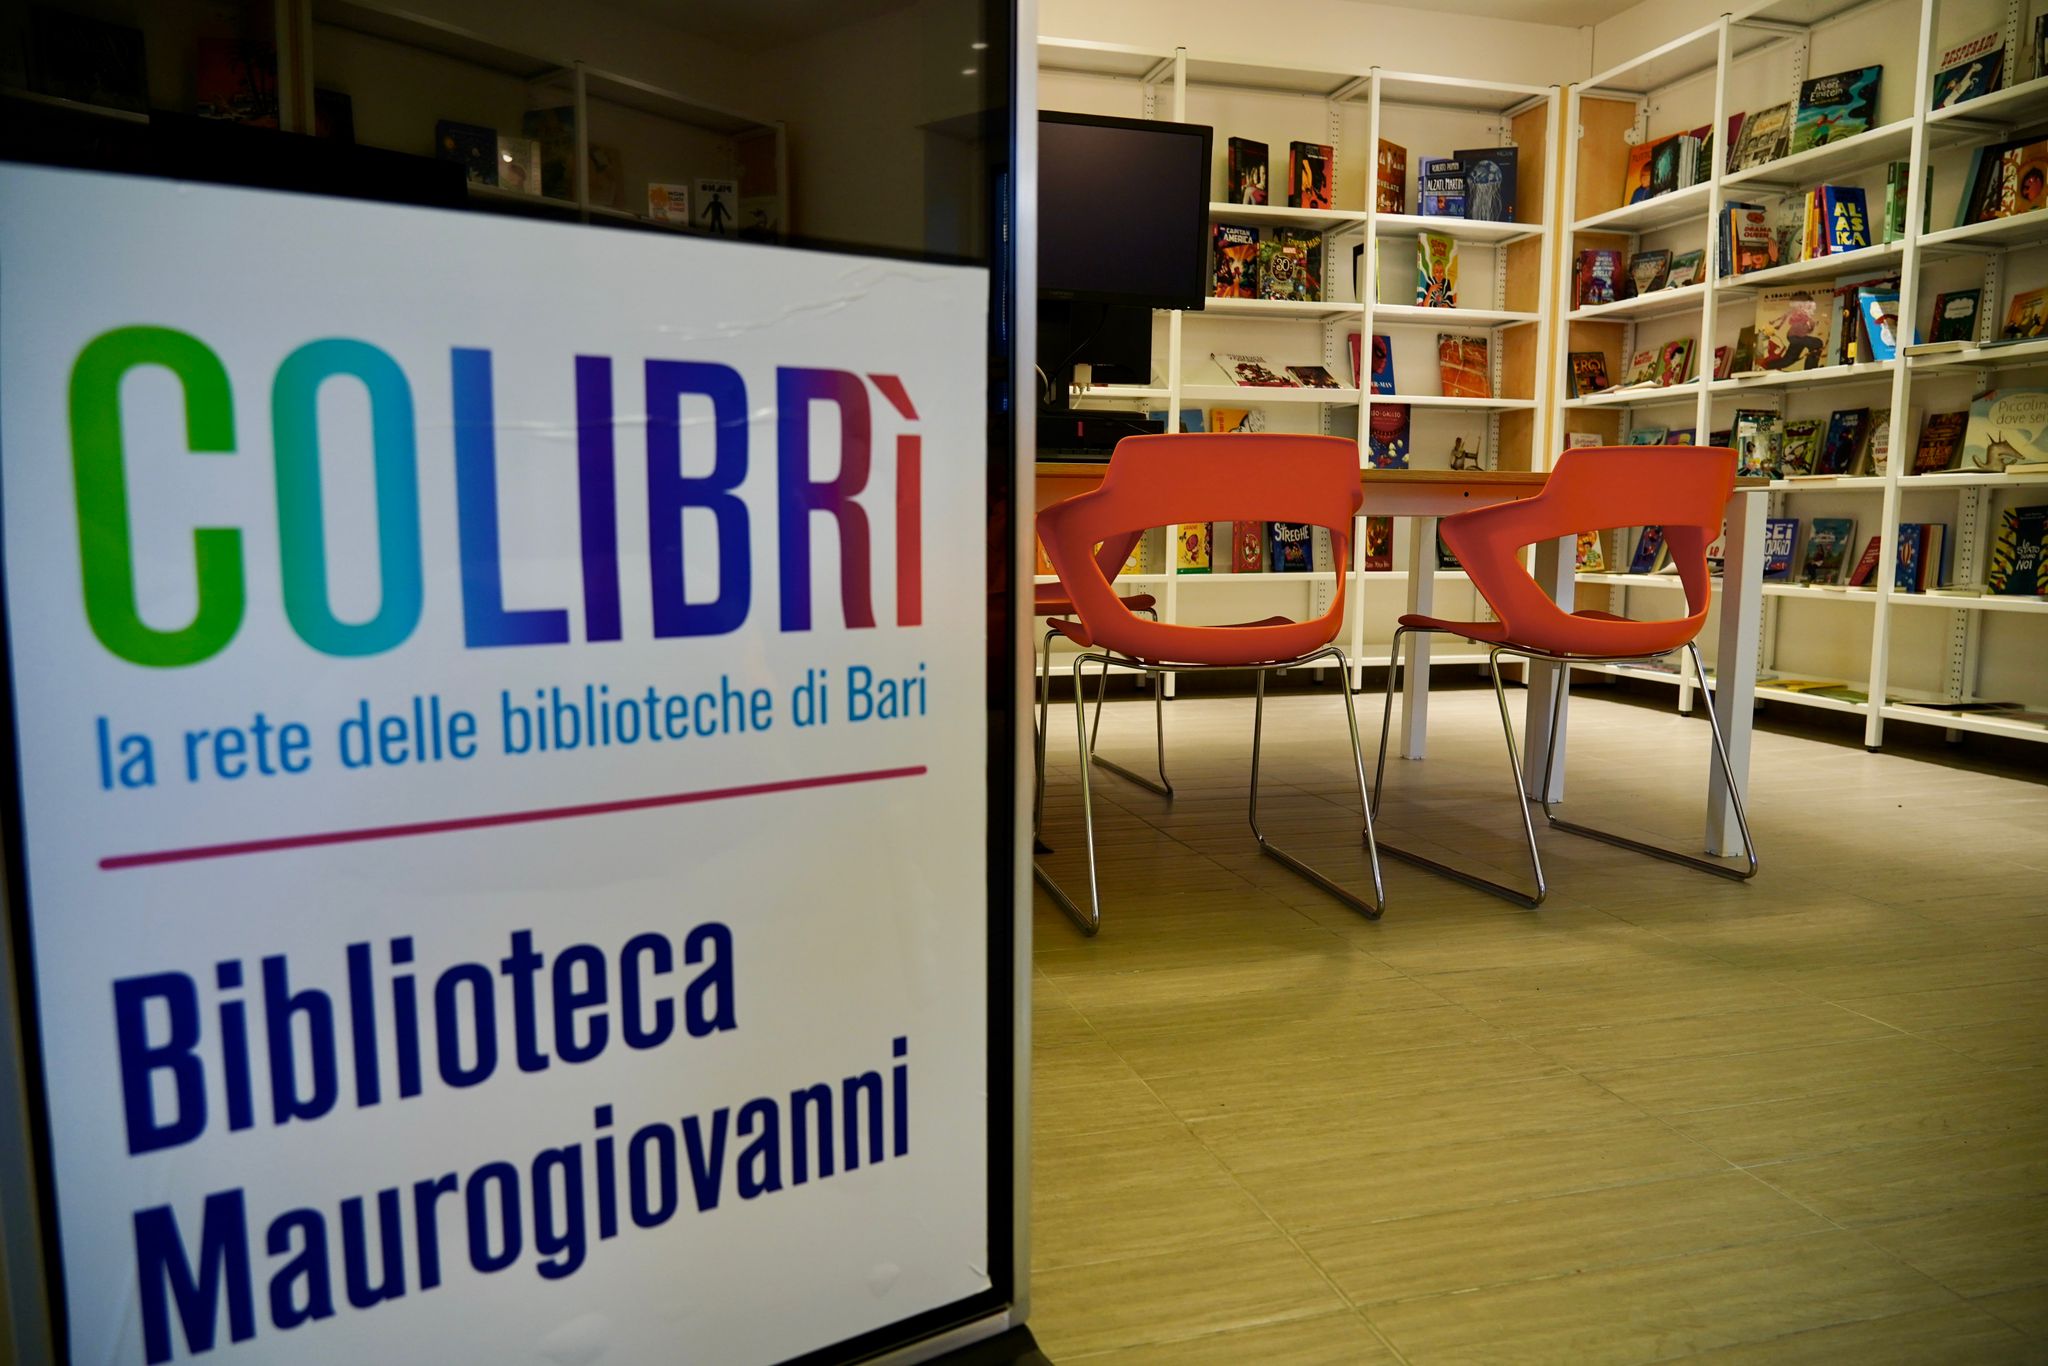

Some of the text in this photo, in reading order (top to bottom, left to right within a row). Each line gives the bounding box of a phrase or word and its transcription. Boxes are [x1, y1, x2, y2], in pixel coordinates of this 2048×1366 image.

[1941, 31, 1999, 67] DESPERADO
[1223, 233, 1253, 244] AMERICA
[1276, 257, 1290, 272] 30
[1997, 413, 2025, 425] dove
[68, 324, 922, 668] COLIBRÌ
[1274, 522, 1310, 542] STREGHE
[2016, 560, 2033, 571] NOI
[96, 662, 927, 790] la rete delle biblioteche di Bari
[111, 921, 738, 1157] Biblioteca
[131, 1036, 910, 1366] Maurogiovanni
